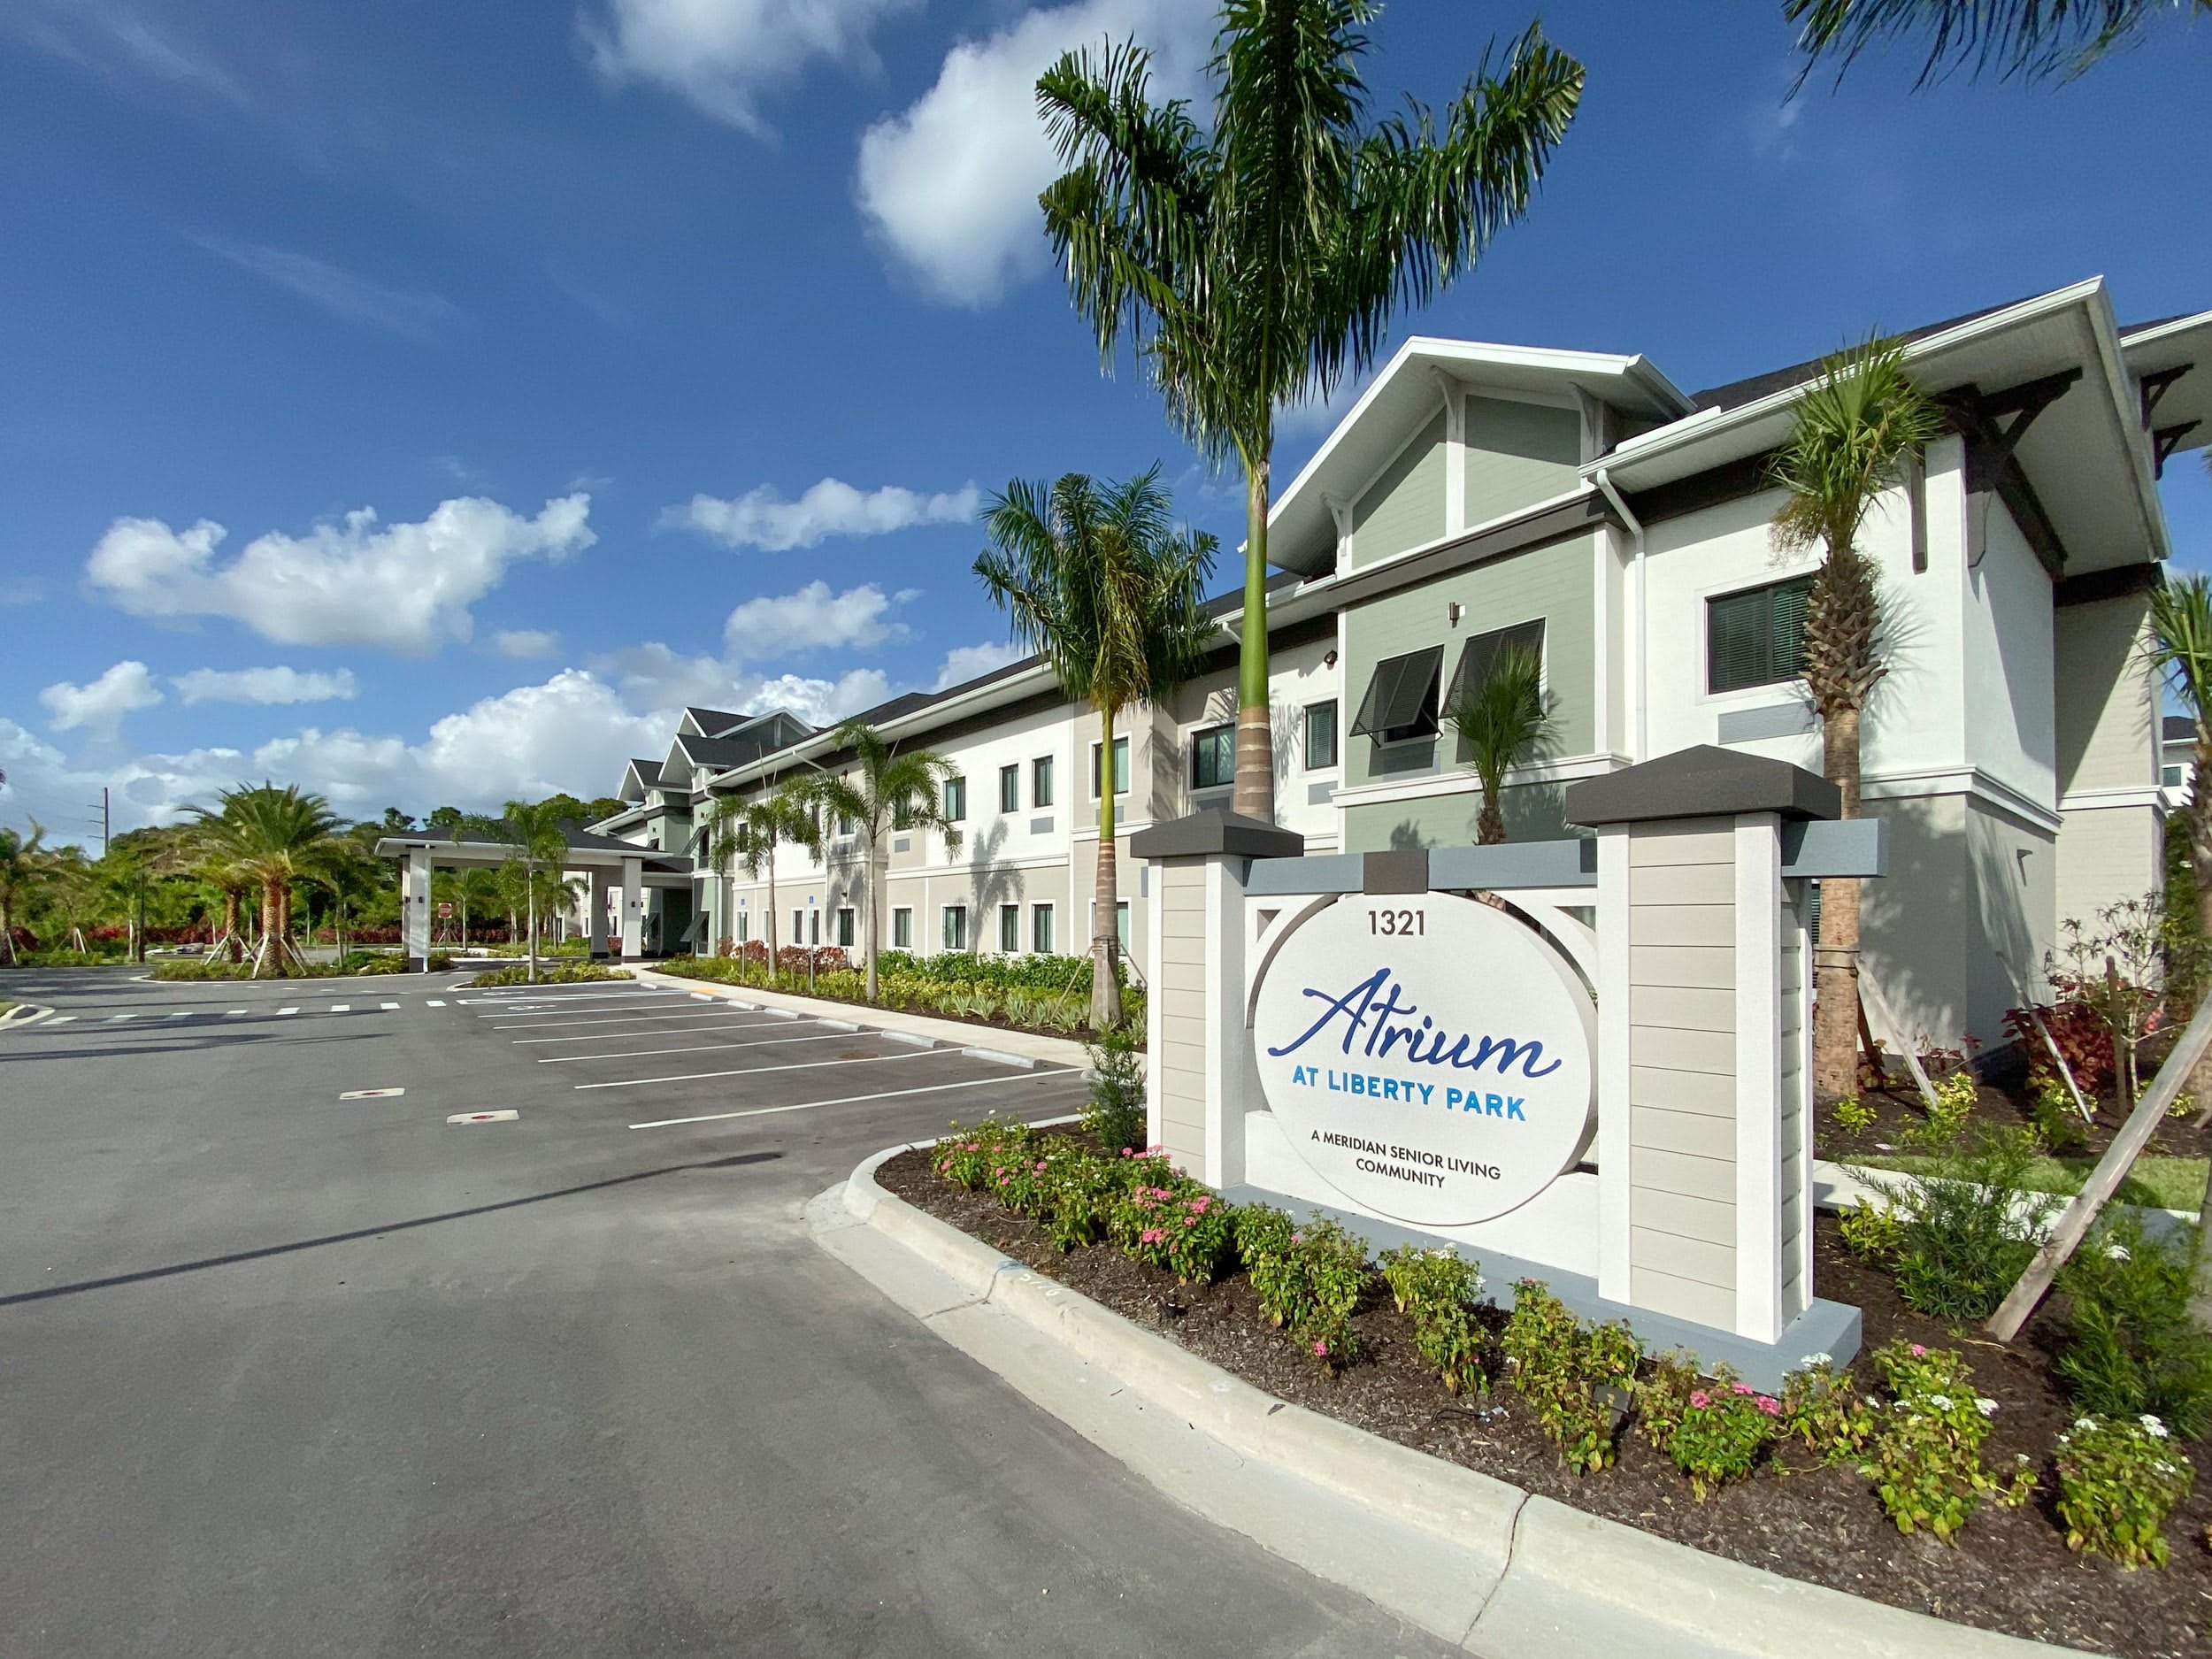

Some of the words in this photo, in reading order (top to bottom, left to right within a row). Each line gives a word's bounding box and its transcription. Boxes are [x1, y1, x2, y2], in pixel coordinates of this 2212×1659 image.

[1369, 910, 1424, 935] 1321
[1268, 968, 1562, 1078] Atrium
[1293, 1066, 1318, 1087] AT
[1329, 1071, 1434, 1106] LIBERTY
[1447, 1087, 1525, 1122] PARK
[1310, 1129, 1320, 1141] A
[1324, 1133, 1386, 1156] MERIDIAN
[1390, 1145, 1443, 1168] SENIOR
[1448, 1157, 1501, 1180] LIVING
[1356, 1158, 1444, 1188] COMMUNITY
